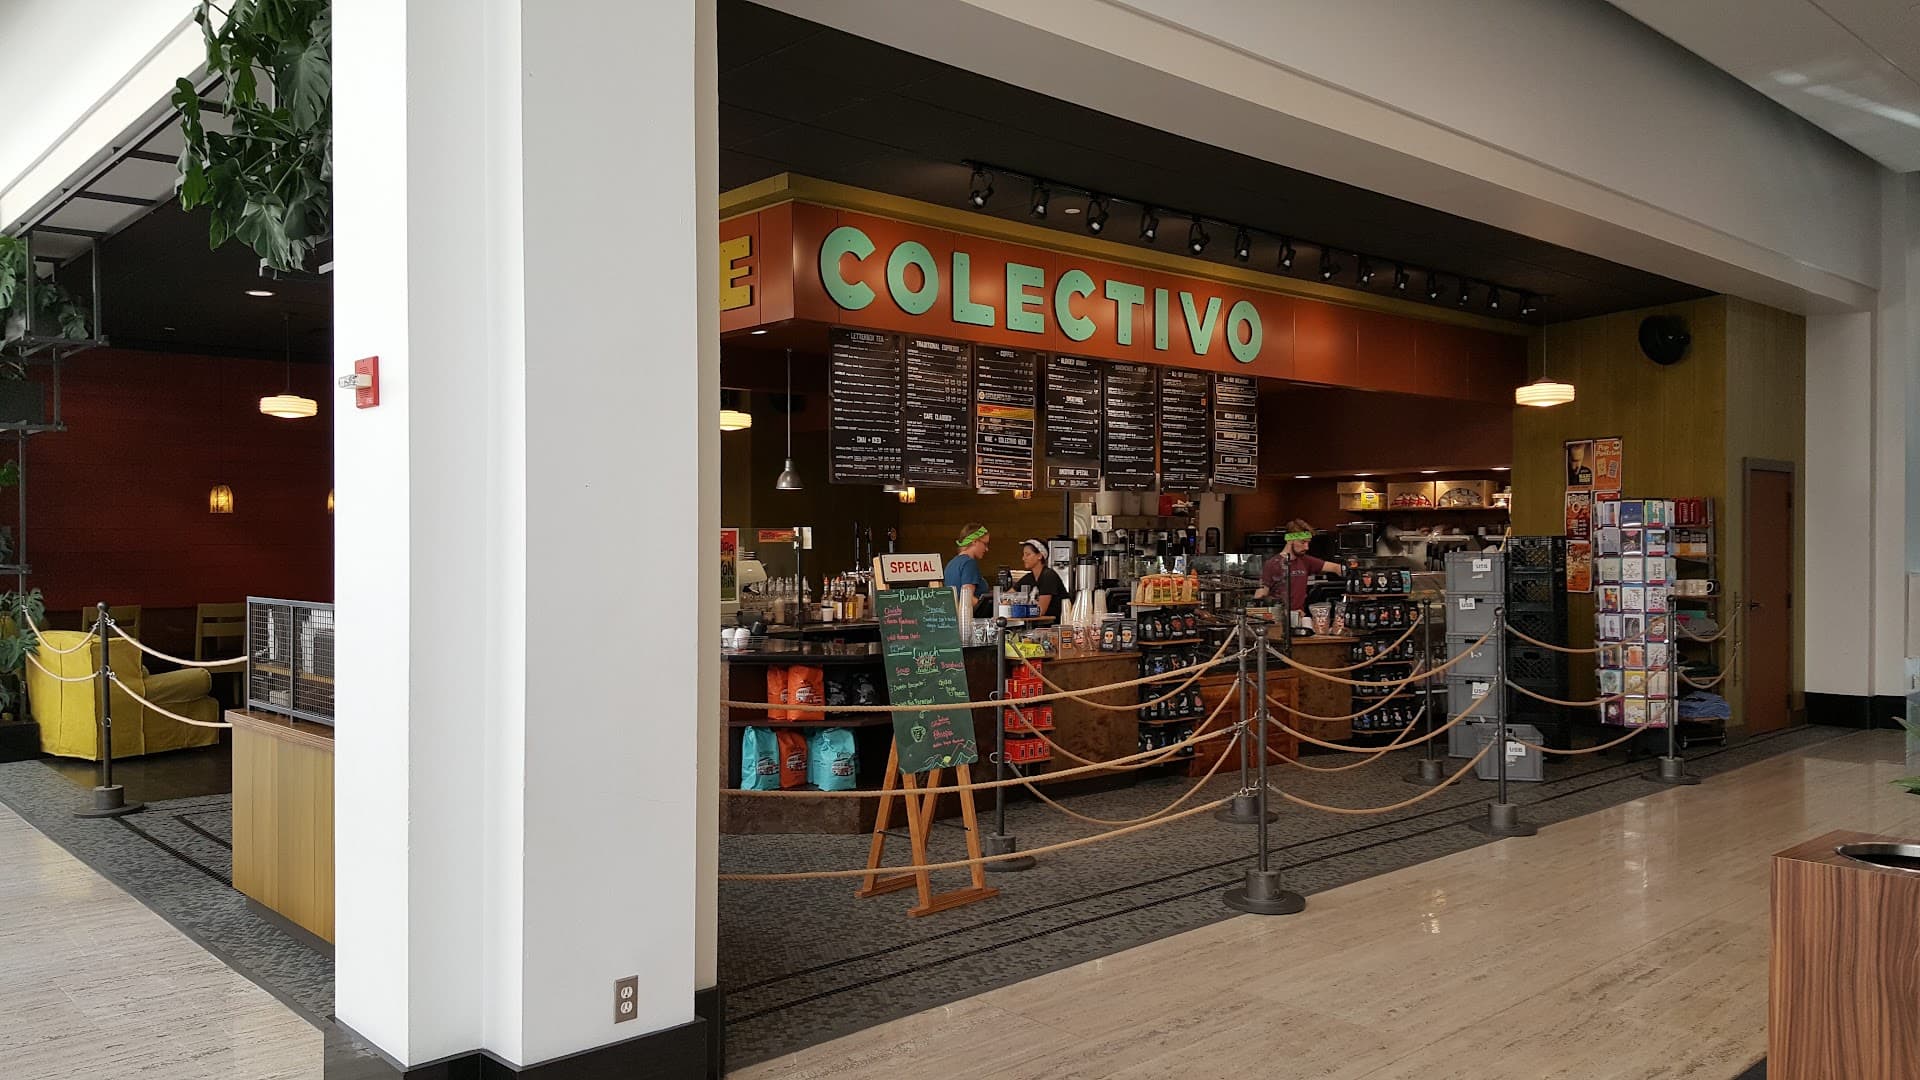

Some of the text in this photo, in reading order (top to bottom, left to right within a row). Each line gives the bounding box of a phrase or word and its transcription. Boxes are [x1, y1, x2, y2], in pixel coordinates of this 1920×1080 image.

[819, 225, 1263, 364] COLECTIVO
[889, 560, 936, 574] SPECIAL
[912, 646, 941, 660] Lunch
